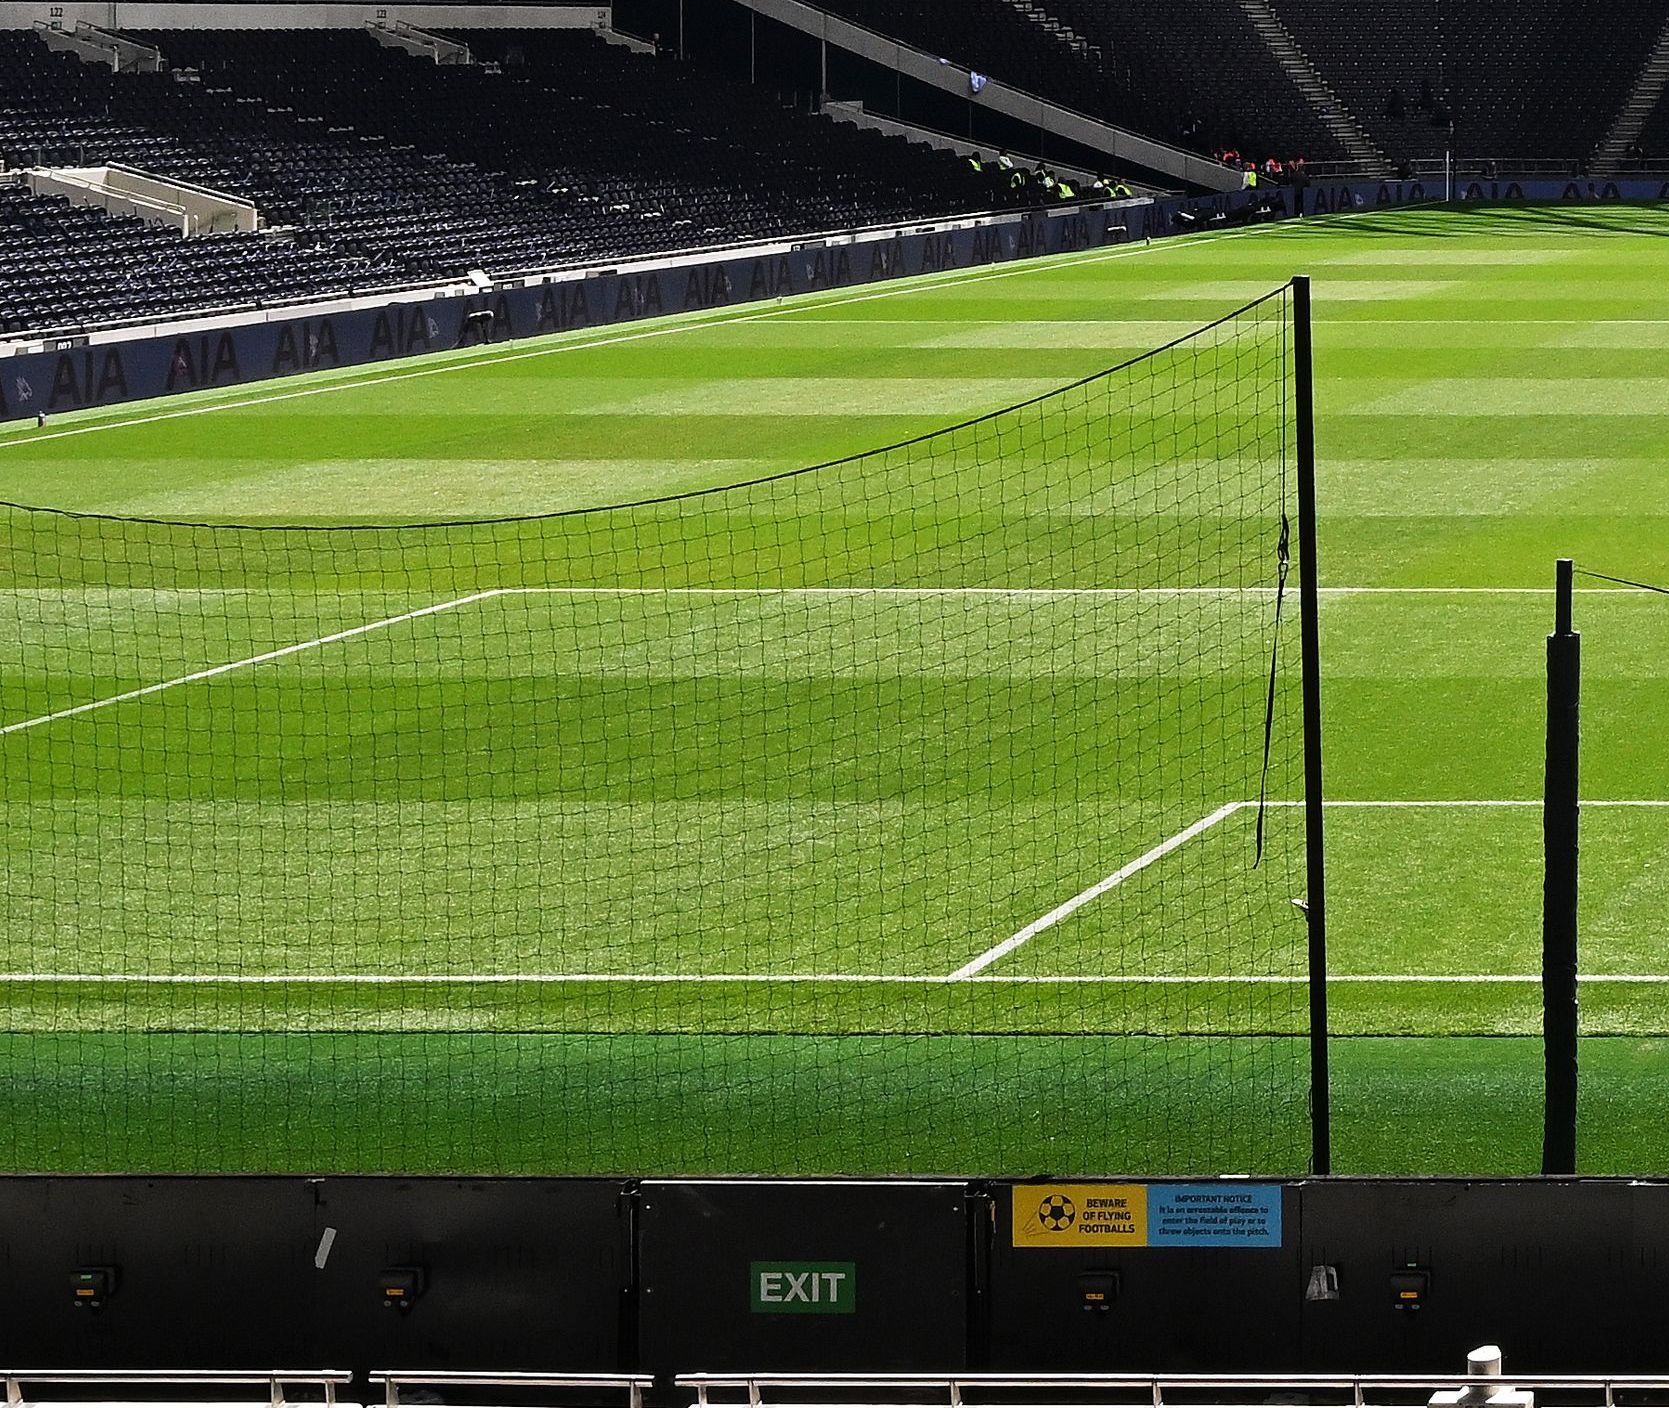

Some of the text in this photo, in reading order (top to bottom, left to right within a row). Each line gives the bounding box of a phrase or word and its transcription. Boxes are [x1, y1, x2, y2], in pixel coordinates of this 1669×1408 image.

[1465, 181, 1525, 199] AIA
[370, 305, 431, 357] AIA
[167, 331, 240, 390] AIA
[50, 347, 128, 409] AIA
[1086, 1198, 1128, 1208] BEWARE
[1175, 1195, 1252, 1203] IMPORTANT NOTICE
[1083, 1211, 1132, 1221] OF FLYING
[1079, 1224, 1136, 1234] FOOTBALLS
[761, 1272, 846, 1302] EXIT
